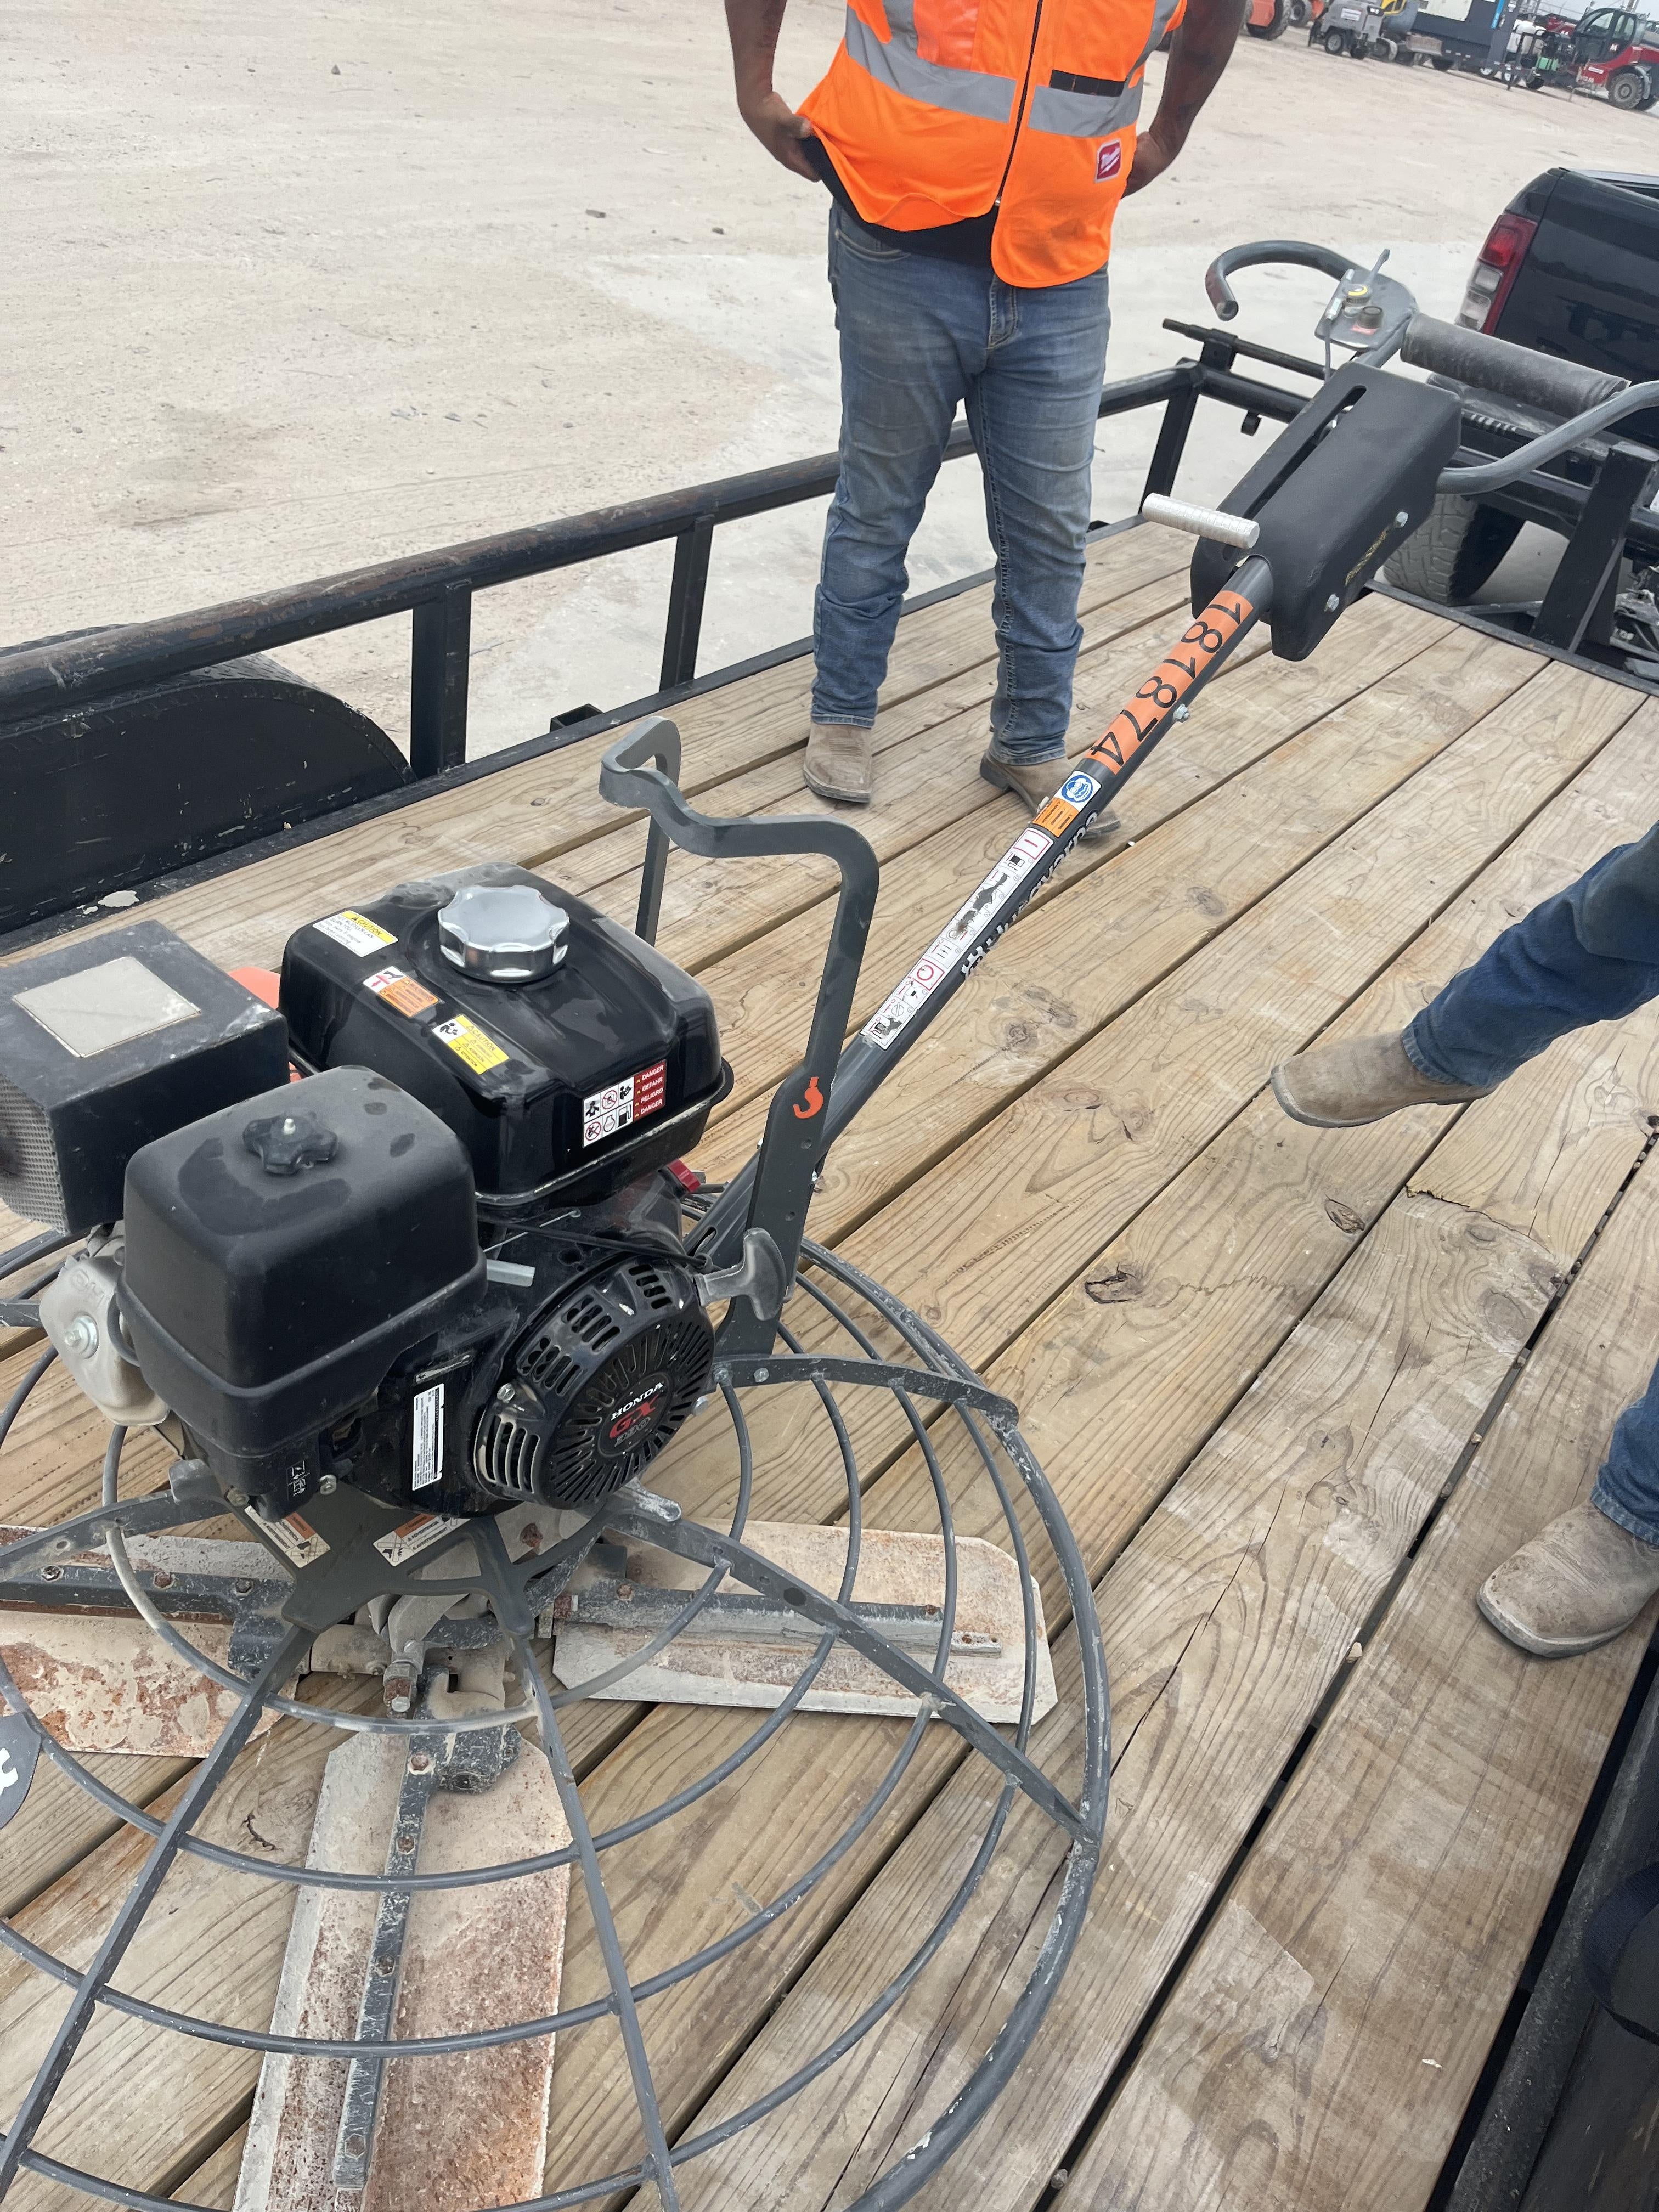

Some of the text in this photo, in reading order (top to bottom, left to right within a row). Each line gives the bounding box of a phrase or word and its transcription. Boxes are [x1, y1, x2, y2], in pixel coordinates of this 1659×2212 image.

[1090, 602, 1241, 767] 181874
[357, 918, 382, 935] CAUTION
[472, 1030, 496, 1051] CAUTION
[641, 1065, 664, 1081] DANGER
[642, 1076, 663, 1092] GEFAHR
[640, 1087, 663, 1104] PELIGRO
[640, 1099, 662, 1115] DANGER
[611, 1383, 664, 1421] HONDA
[609, 1392, 660, 1439] GX
